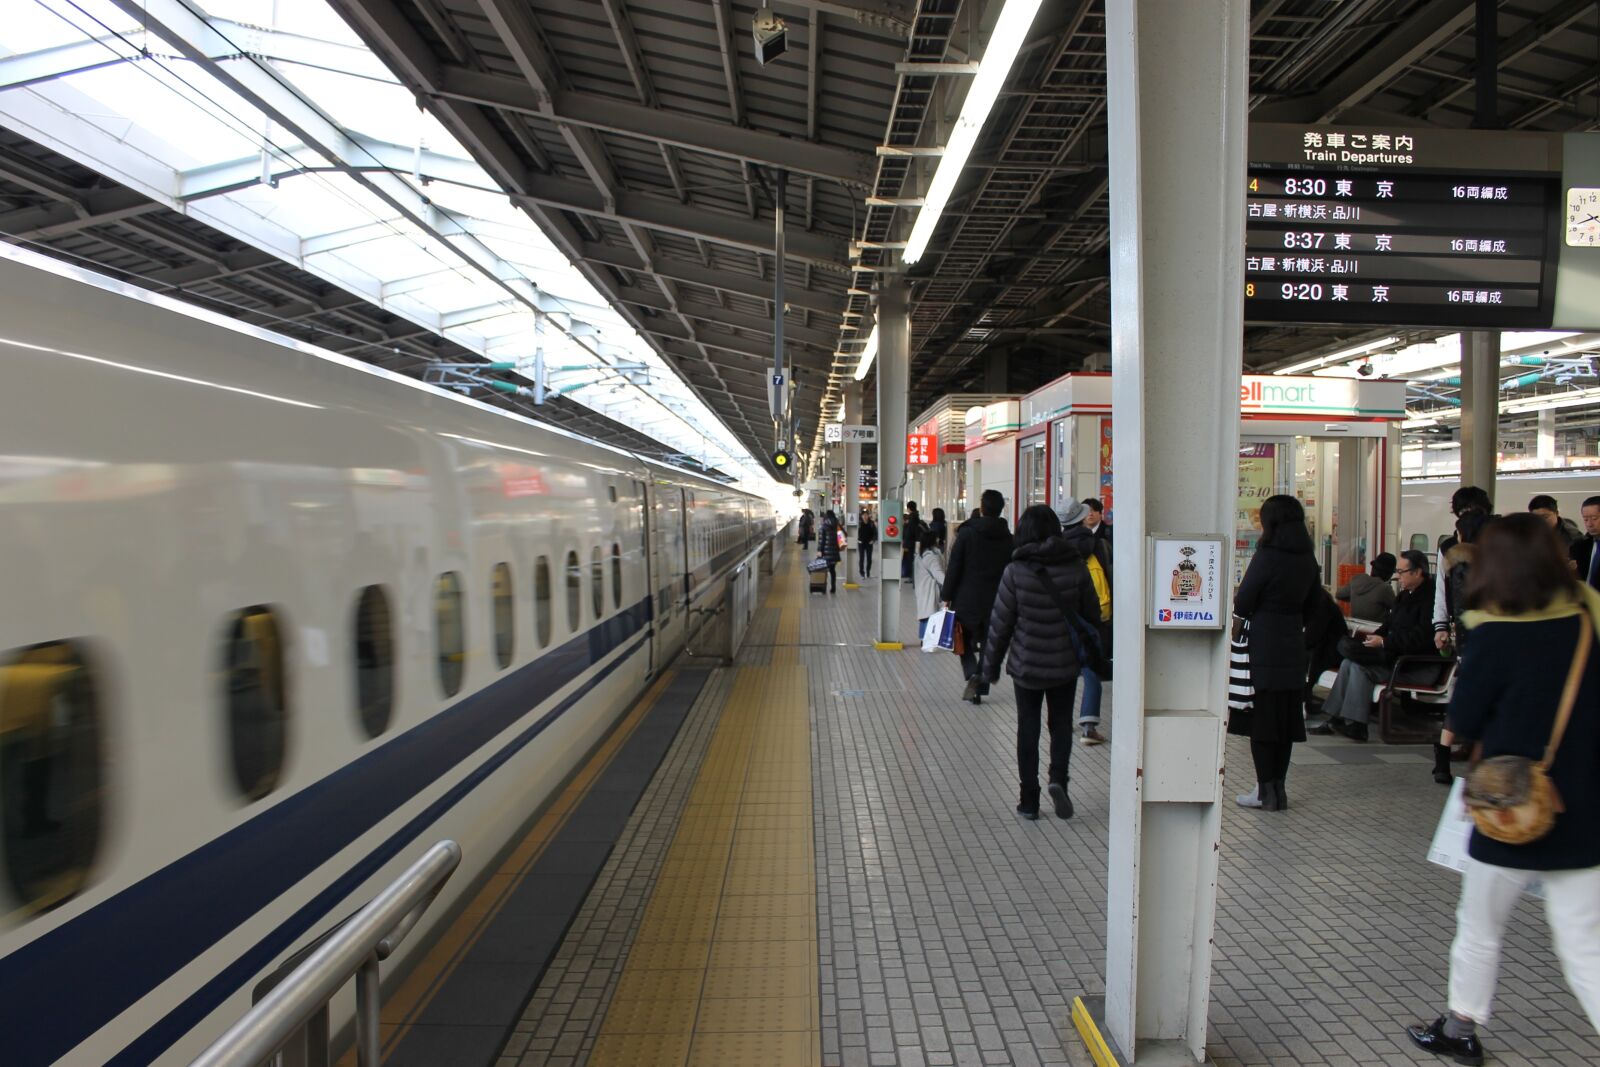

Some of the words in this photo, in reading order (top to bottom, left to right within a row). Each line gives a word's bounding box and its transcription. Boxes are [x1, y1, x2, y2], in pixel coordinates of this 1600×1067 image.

[1304, 132, 1413, 151] 発車ご案内
[1304, 150, 1337, 161] Train
[1341, 151, 1413, 164] Departures
[1285, 178, 1326, 195] 8:30
[1452, 186, 1508, 200] 16両編成
[1283, 232, 1325, 249] 8:37
[1451, 239, 1506, 253] 16両編成
[1589, 235, 1594, 243] 6
[1281, 283, 1322, 300] 9:20
[1447, 291, 1502, 304] 16両編成
[774, 375, 782, 385] 7
[828, 427, 840, 438] 25
[852, 429, 874, 439] 7号車
[1173, 611, 1214, 621] 伊藤ハム
